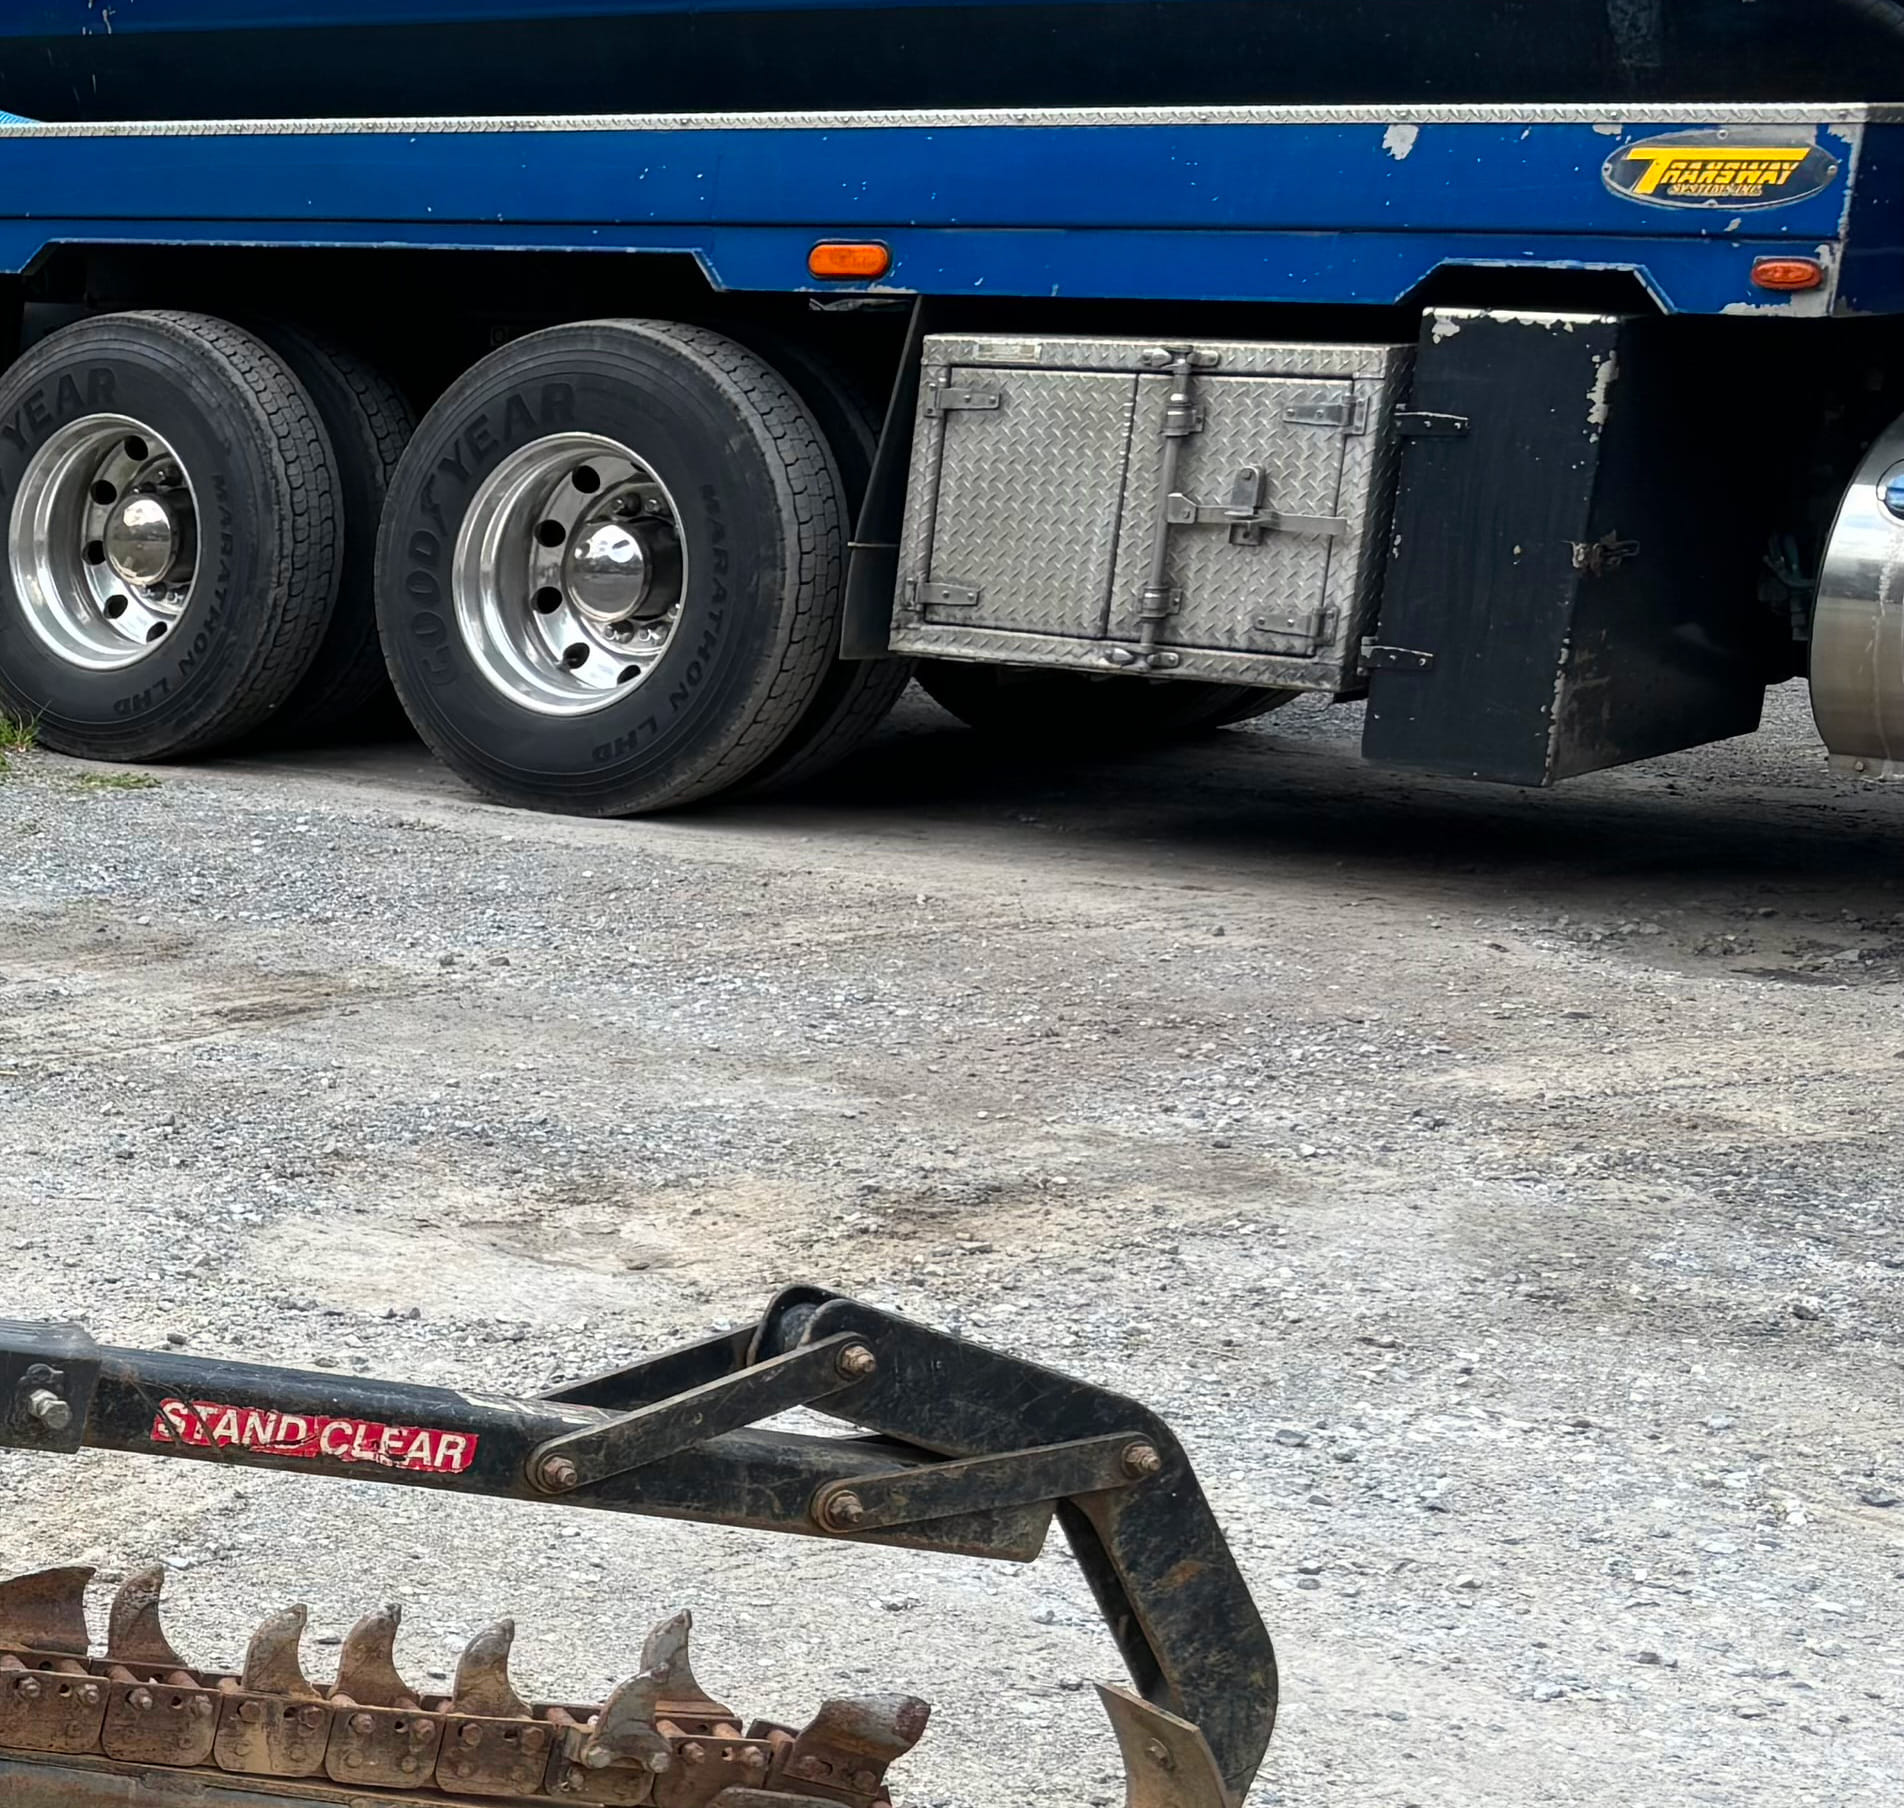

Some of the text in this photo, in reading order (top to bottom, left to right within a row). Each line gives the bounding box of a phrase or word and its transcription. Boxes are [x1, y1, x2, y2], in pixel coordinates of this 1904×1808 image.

[1627, 147, 1810, 195] TRANSWAY
[179, 473, 234, 669] MARATHON
[406, 382, 575, 688] GOODYEAR
[666, 482, 729, 722] MARATHON
[593, 717, 659, 764] LHD
[156, 1402, 469, 1470] STAND CLEAR
